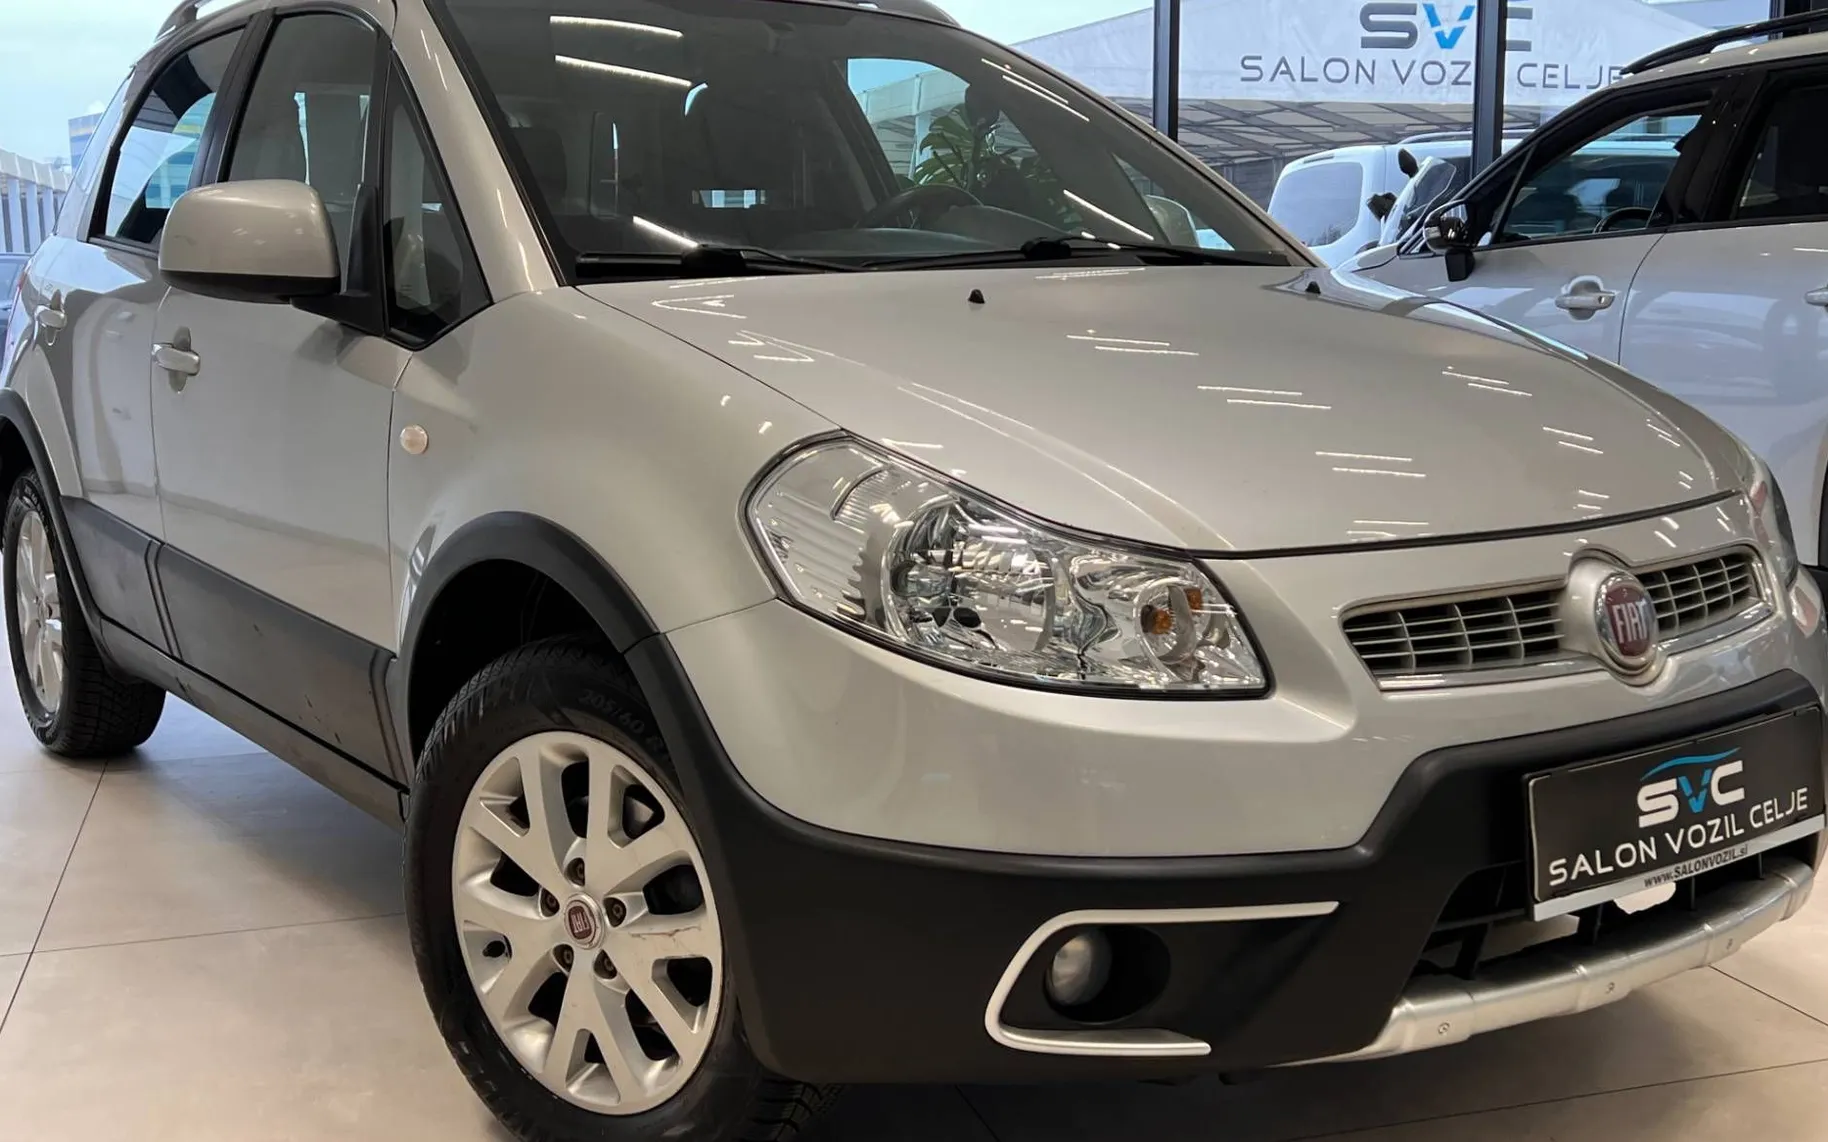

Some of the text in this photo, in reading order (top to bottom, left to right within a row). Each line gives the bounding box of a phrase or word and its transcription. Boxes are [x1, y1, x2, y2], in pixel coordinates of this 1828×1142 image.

[1240, 56, 1376, 85] SALON
[1392, 59, 1472, 87] VOZ
[1612, 597, 1649, 645] FIAT
[1637, 760, 1745, 829] SVC
[1549, 787, 1809, 887] SALON VOZIL CELJE
[1643, 843, 1749, 888] www.SALONVOZIL.si
